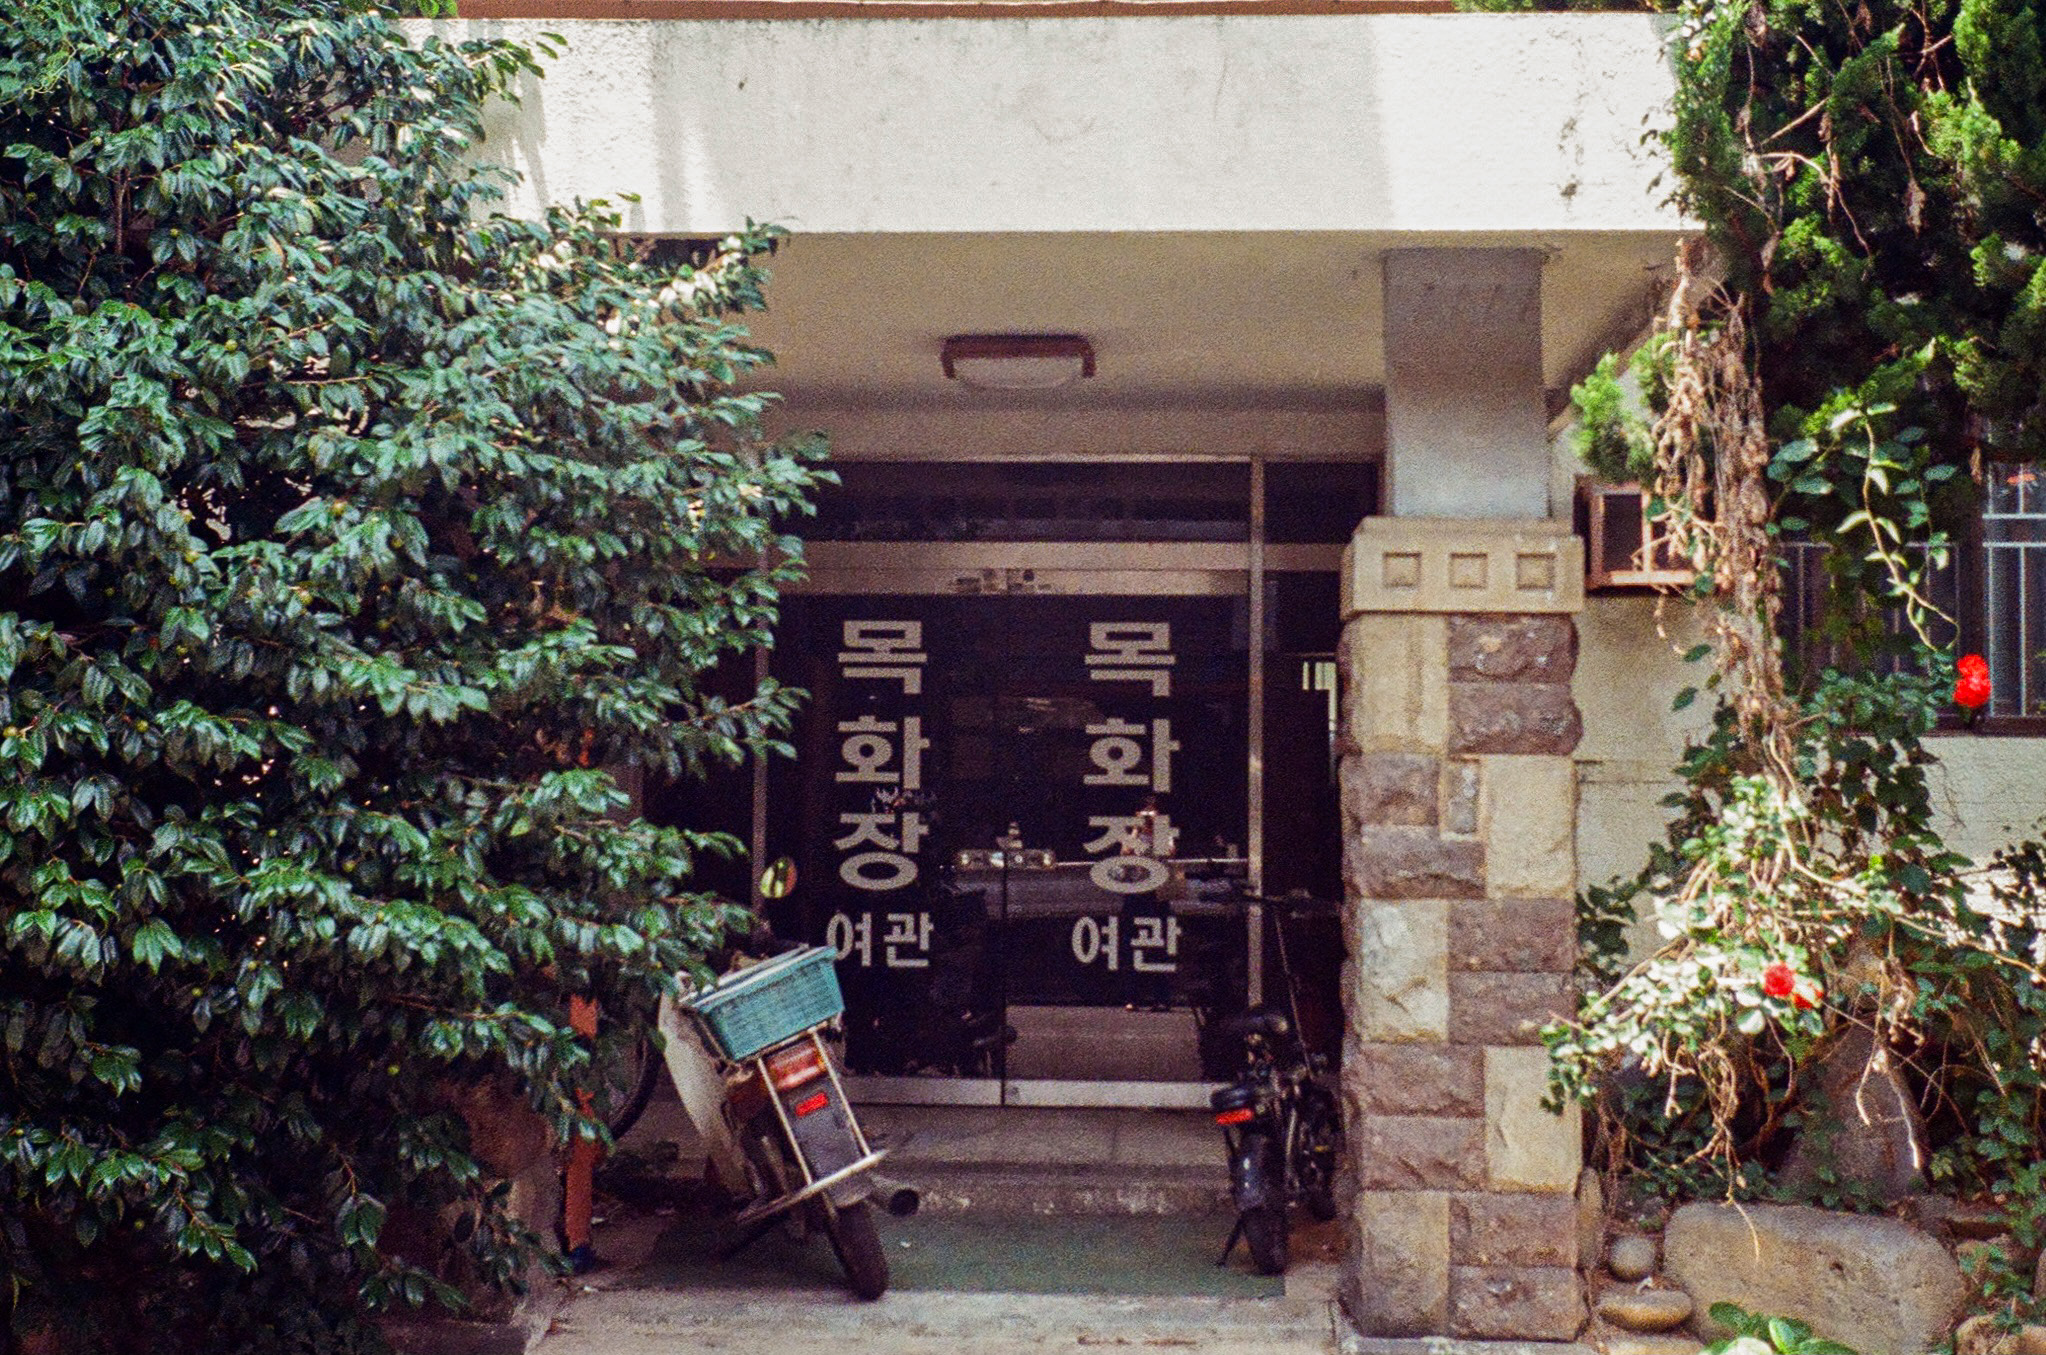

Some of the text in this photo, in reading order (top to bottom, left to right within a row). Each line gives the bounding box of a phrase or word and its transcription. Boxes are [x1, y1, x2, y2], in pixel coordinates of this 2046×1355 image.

[834, 620, 931, 892] 목화장
[1083, 622, 1181, 895] 목화장
[826, 912, 934, 969] 여관
[1072, 915, 1182, 973] 여관
